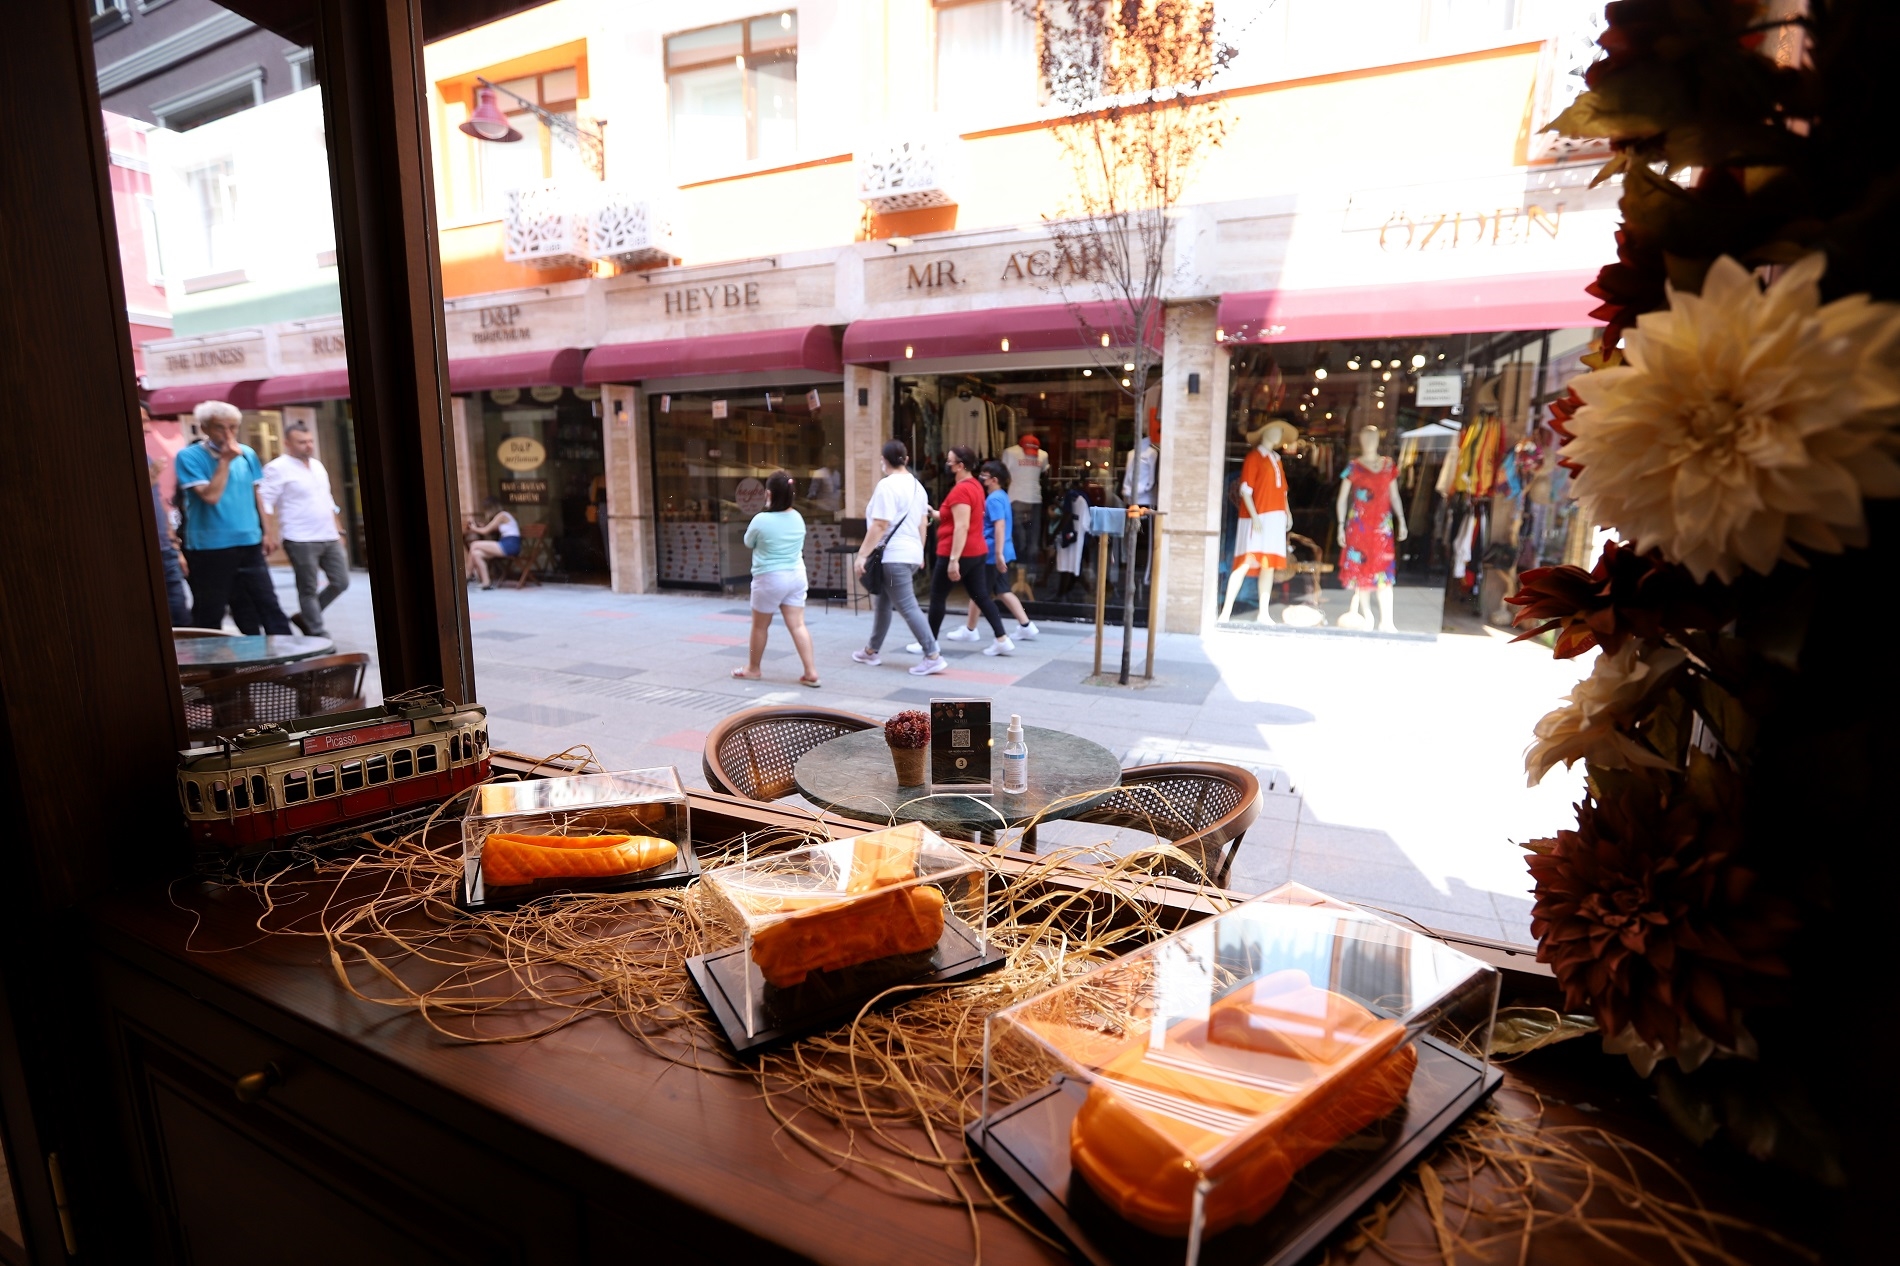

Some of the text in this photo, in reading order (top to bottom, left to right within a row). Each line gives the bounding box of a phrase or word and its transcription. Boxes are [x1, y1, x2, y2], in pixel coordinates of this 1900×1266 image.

[1378, 203, 1568, 252] ÖZDEN
[907, 259, 967, 289] MR.
[664, 281, 760, 315] HEYBE
[480, 304, 521, 329] D&P
[165, 346, 245, 372] THE LIONESS
[325, 735, 357, 748] Picasso
